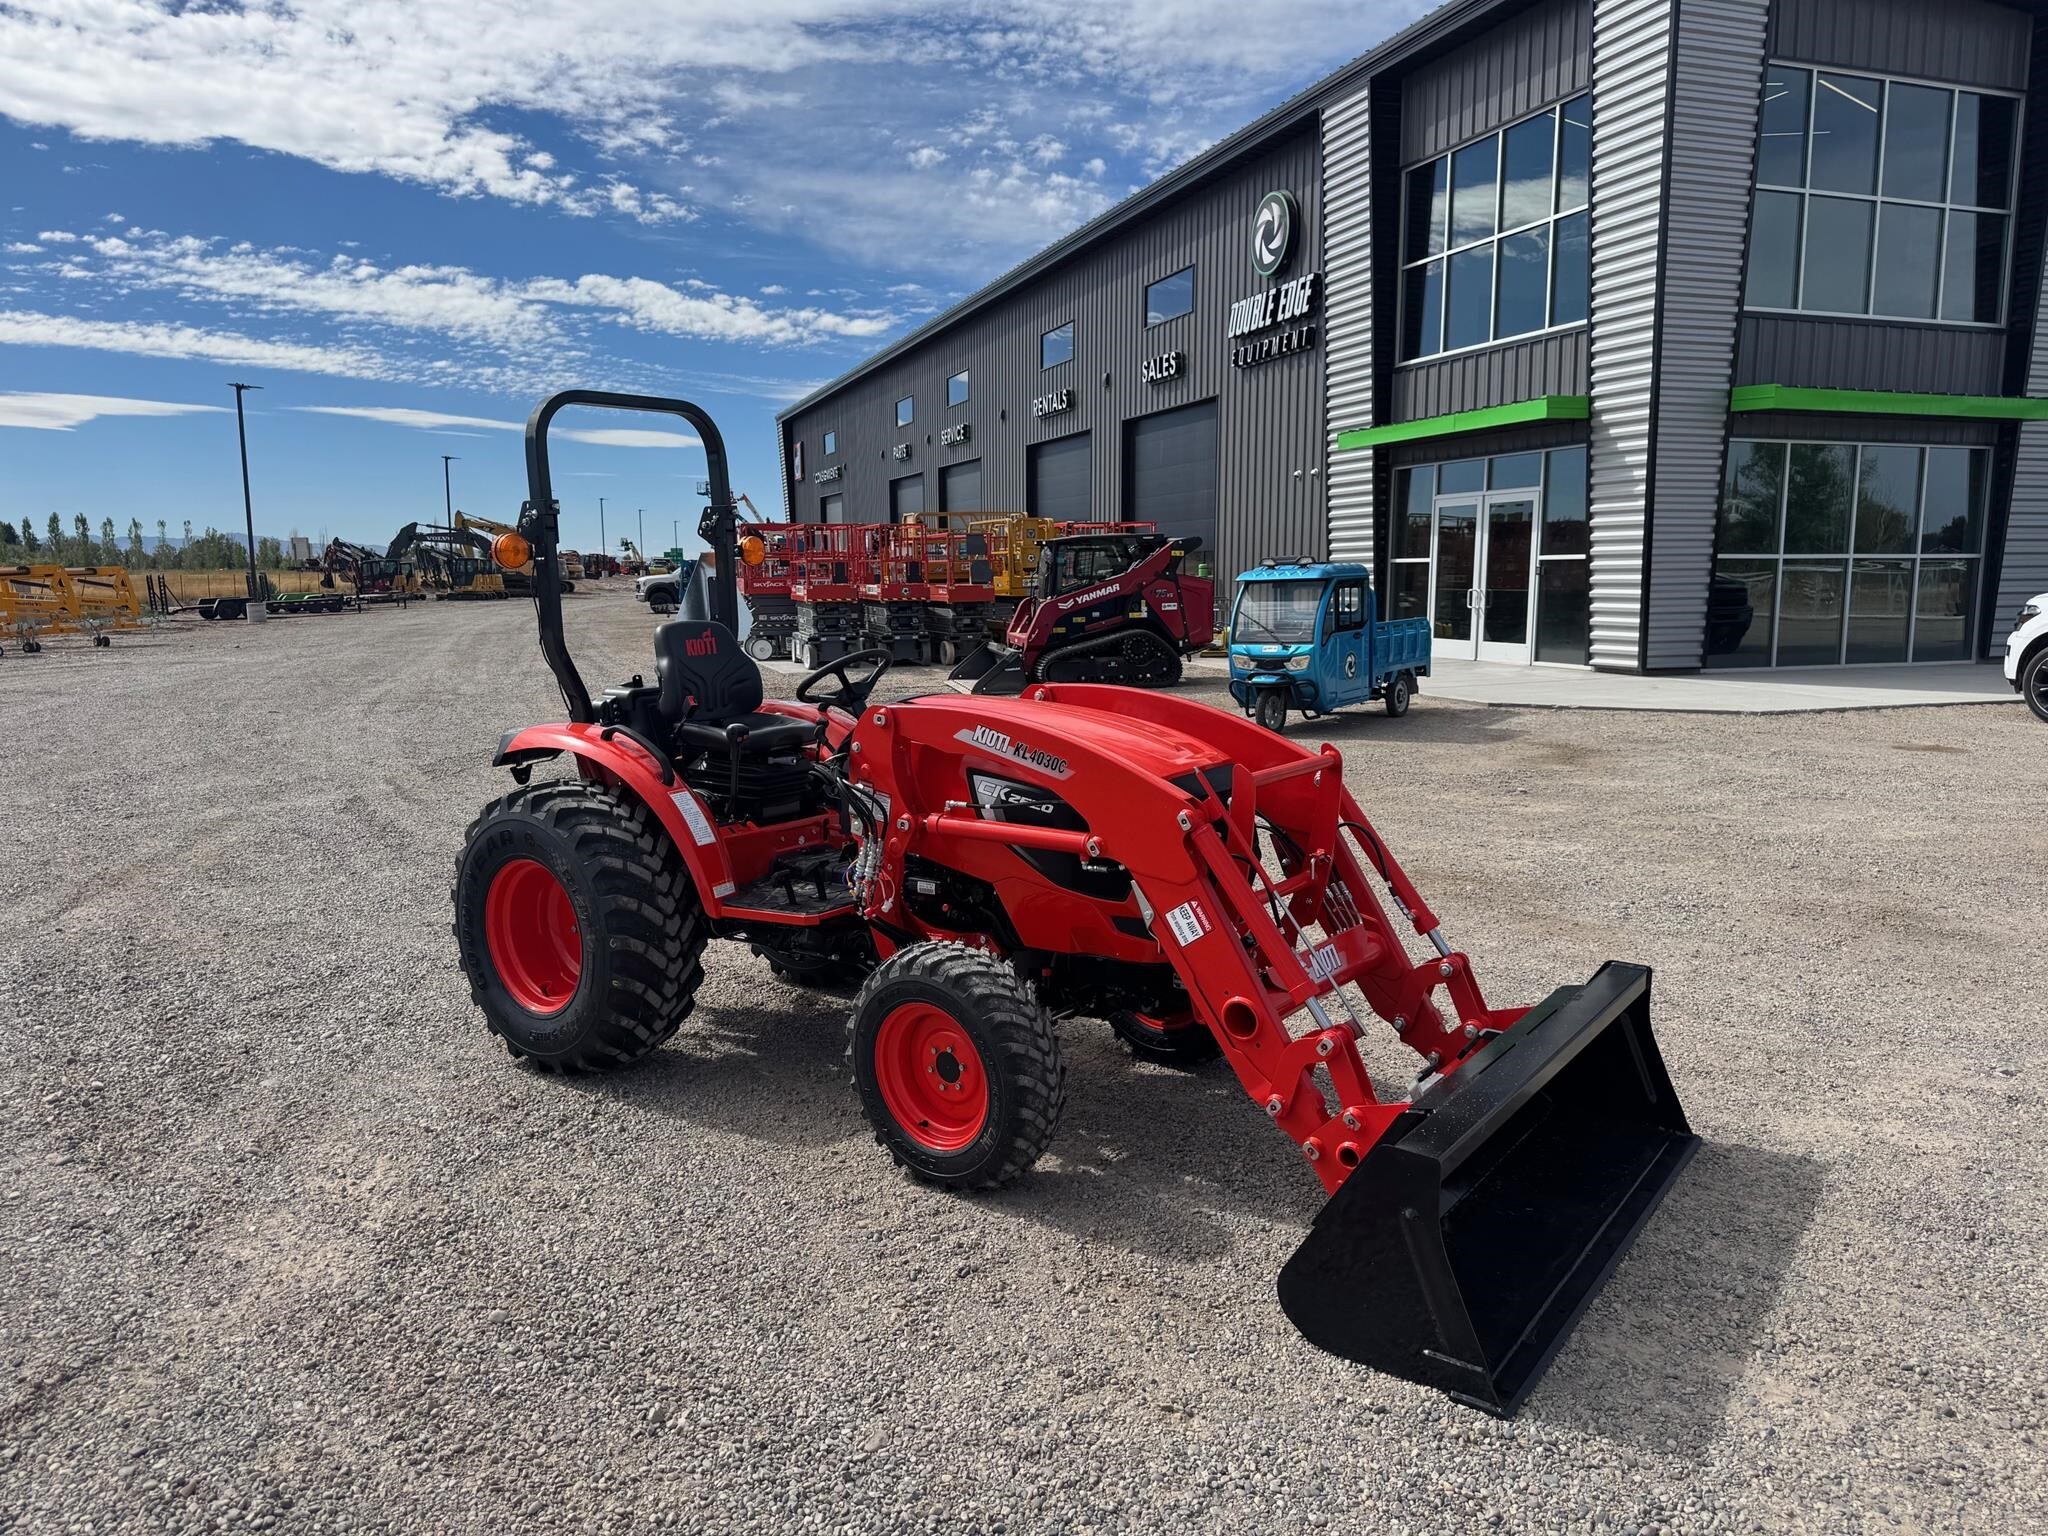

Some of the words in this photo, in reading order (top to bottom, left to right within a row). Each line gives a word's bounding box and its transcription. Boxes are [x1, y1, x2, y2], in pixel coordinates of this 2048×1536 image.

[1228, 287, 1277, 339] DOUBLE
[1277, 272, 1315, 322] EDGE
[1231, 326, 1308, 368] EQUIPMENT
[1141, 351, 1177, 384] SALES
[1032, 388, 1069, 418] RENTALS
[941, 423, 965, 446] SERVICE
[753, 580, 785, 588] SKYJACK
[1075, 583, 1121, 604] YANMAR
[684, 628, 718, 657] KIOTI
[972, 724, 1011, 753] KIOTI
[1013, 742, 1067, 774] KL4030C
[1178, 905, 1191, 921] KEEP
[1186, 920, 1201, 938] AWAY
[1196, 906, 1212, 932] WARNING
